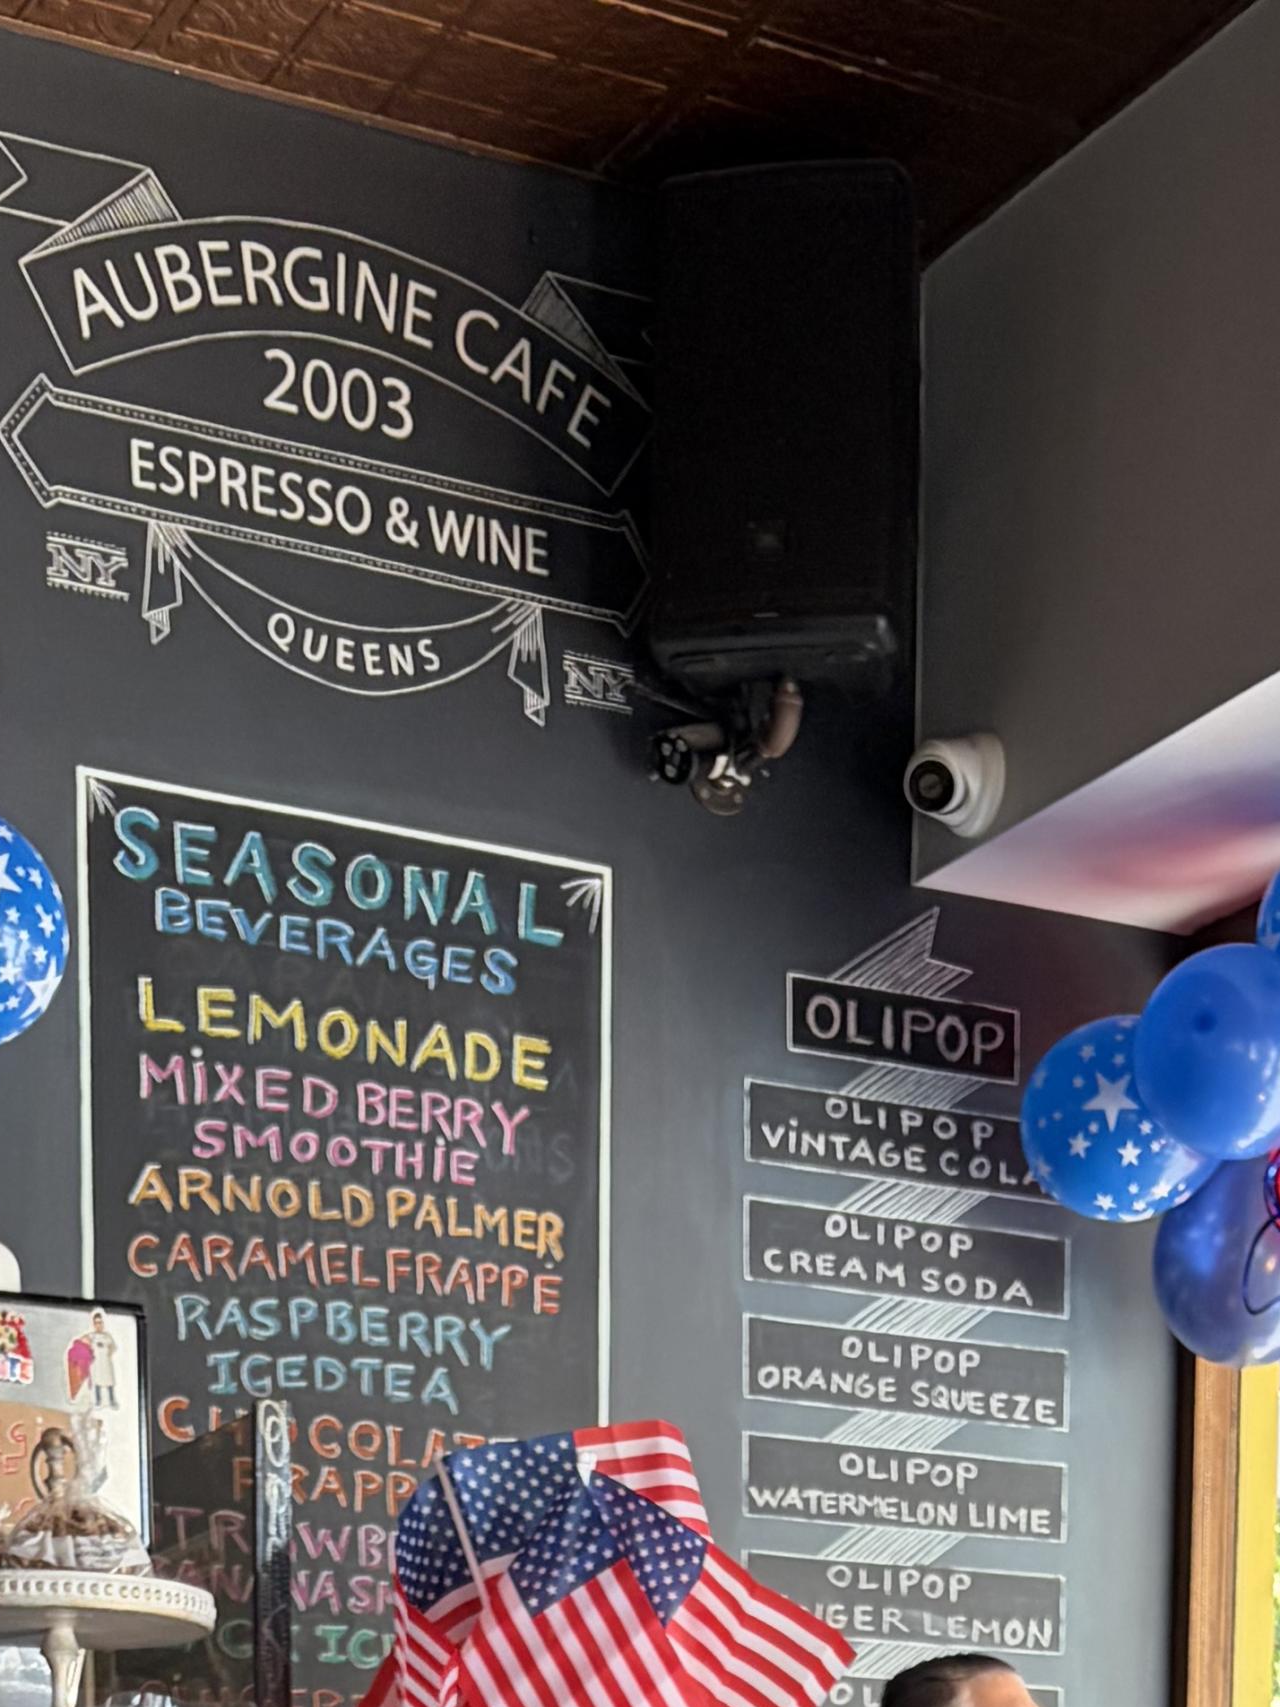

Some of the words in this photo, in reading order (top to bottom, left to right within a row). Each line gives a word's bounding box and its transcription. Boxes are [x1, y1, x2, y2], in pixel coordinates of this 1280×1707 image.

[74, 240, 437, 349] AUBERGINE
[455, 309, 611, 449] CAFE
[263, 348, 413, 439] 2003
[129, 438, 372, 536] ESPRESSO
[385, 495, 419, 548] &
[427, 505, 549, 576] WINE
[46, 542, 129, 587] NY
[266, 611, 441, 678] QUEENS
[563, 660, 634, 703] NY
[113, 806, 564, 947] SEASONAL
[155, 886, 518, 995] BEVERAGES
[137, 975, 551, 1091] LEMONADE
[806, 994, 1006, 1065] OLIPOP
[356, 1081, 531, 1157] BERRY
[825, 1097, 994, 1150] OLIPOP
[128, 1162, 373, 1229] ARNOLD
[386, 1186, 566, 1262] PALMER
[825, 1213, 974, 1258] OLIPOP
[127, 1232, 381, 1288] CARAMEL
[763, 1247, 907, 1288] CREAM
[921, 1267, 1034, 1307] SODA
[174, 1293, 513, 1371] RASPBERRY
[841, 1336, 981, 1378] OLIPOP
[350, 1357, 460, 1417] TEA
[757, 1365, 898, 1403] ORANGE
[911, 1382, 1058, 1426] SQUEEZE
[839, 1452, 979, 1495] OLIPOP
[749, 1486, 958, 1527] WATERMELON
[967, 1501, 1051, 1535] LIME
[826, 1564, 973, 1603] OLIPOP
[812, 1602, 910, 1634] GER
[921, 1611, 1054, 1650] LEMON
